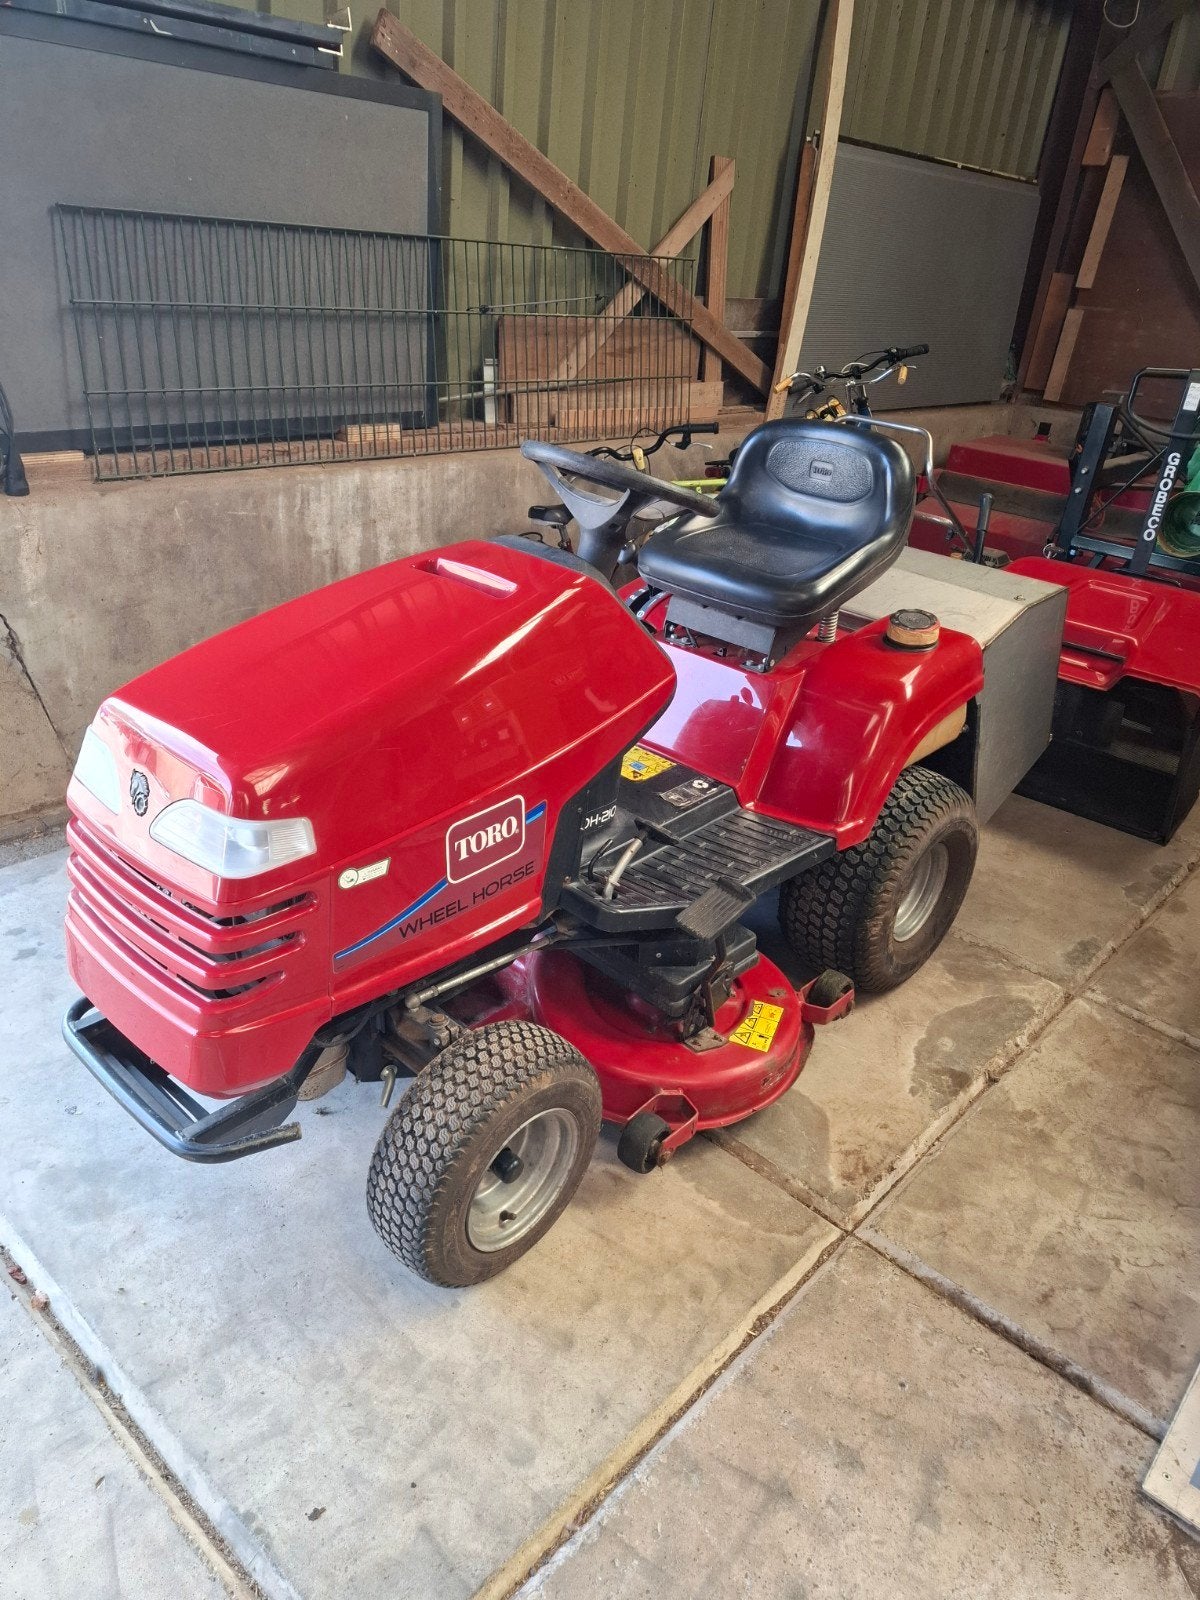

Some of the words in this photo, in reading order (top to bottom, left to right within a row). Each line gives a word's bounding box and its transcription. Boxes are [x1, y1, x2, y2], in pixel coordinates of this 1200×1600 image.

[1143, 452, 1181, 541] GROBECO
[454, 815, 518, 861] TORO
[398, 899, 469, 939] WHEEL
[472, 860, 536, 905] HORSE
